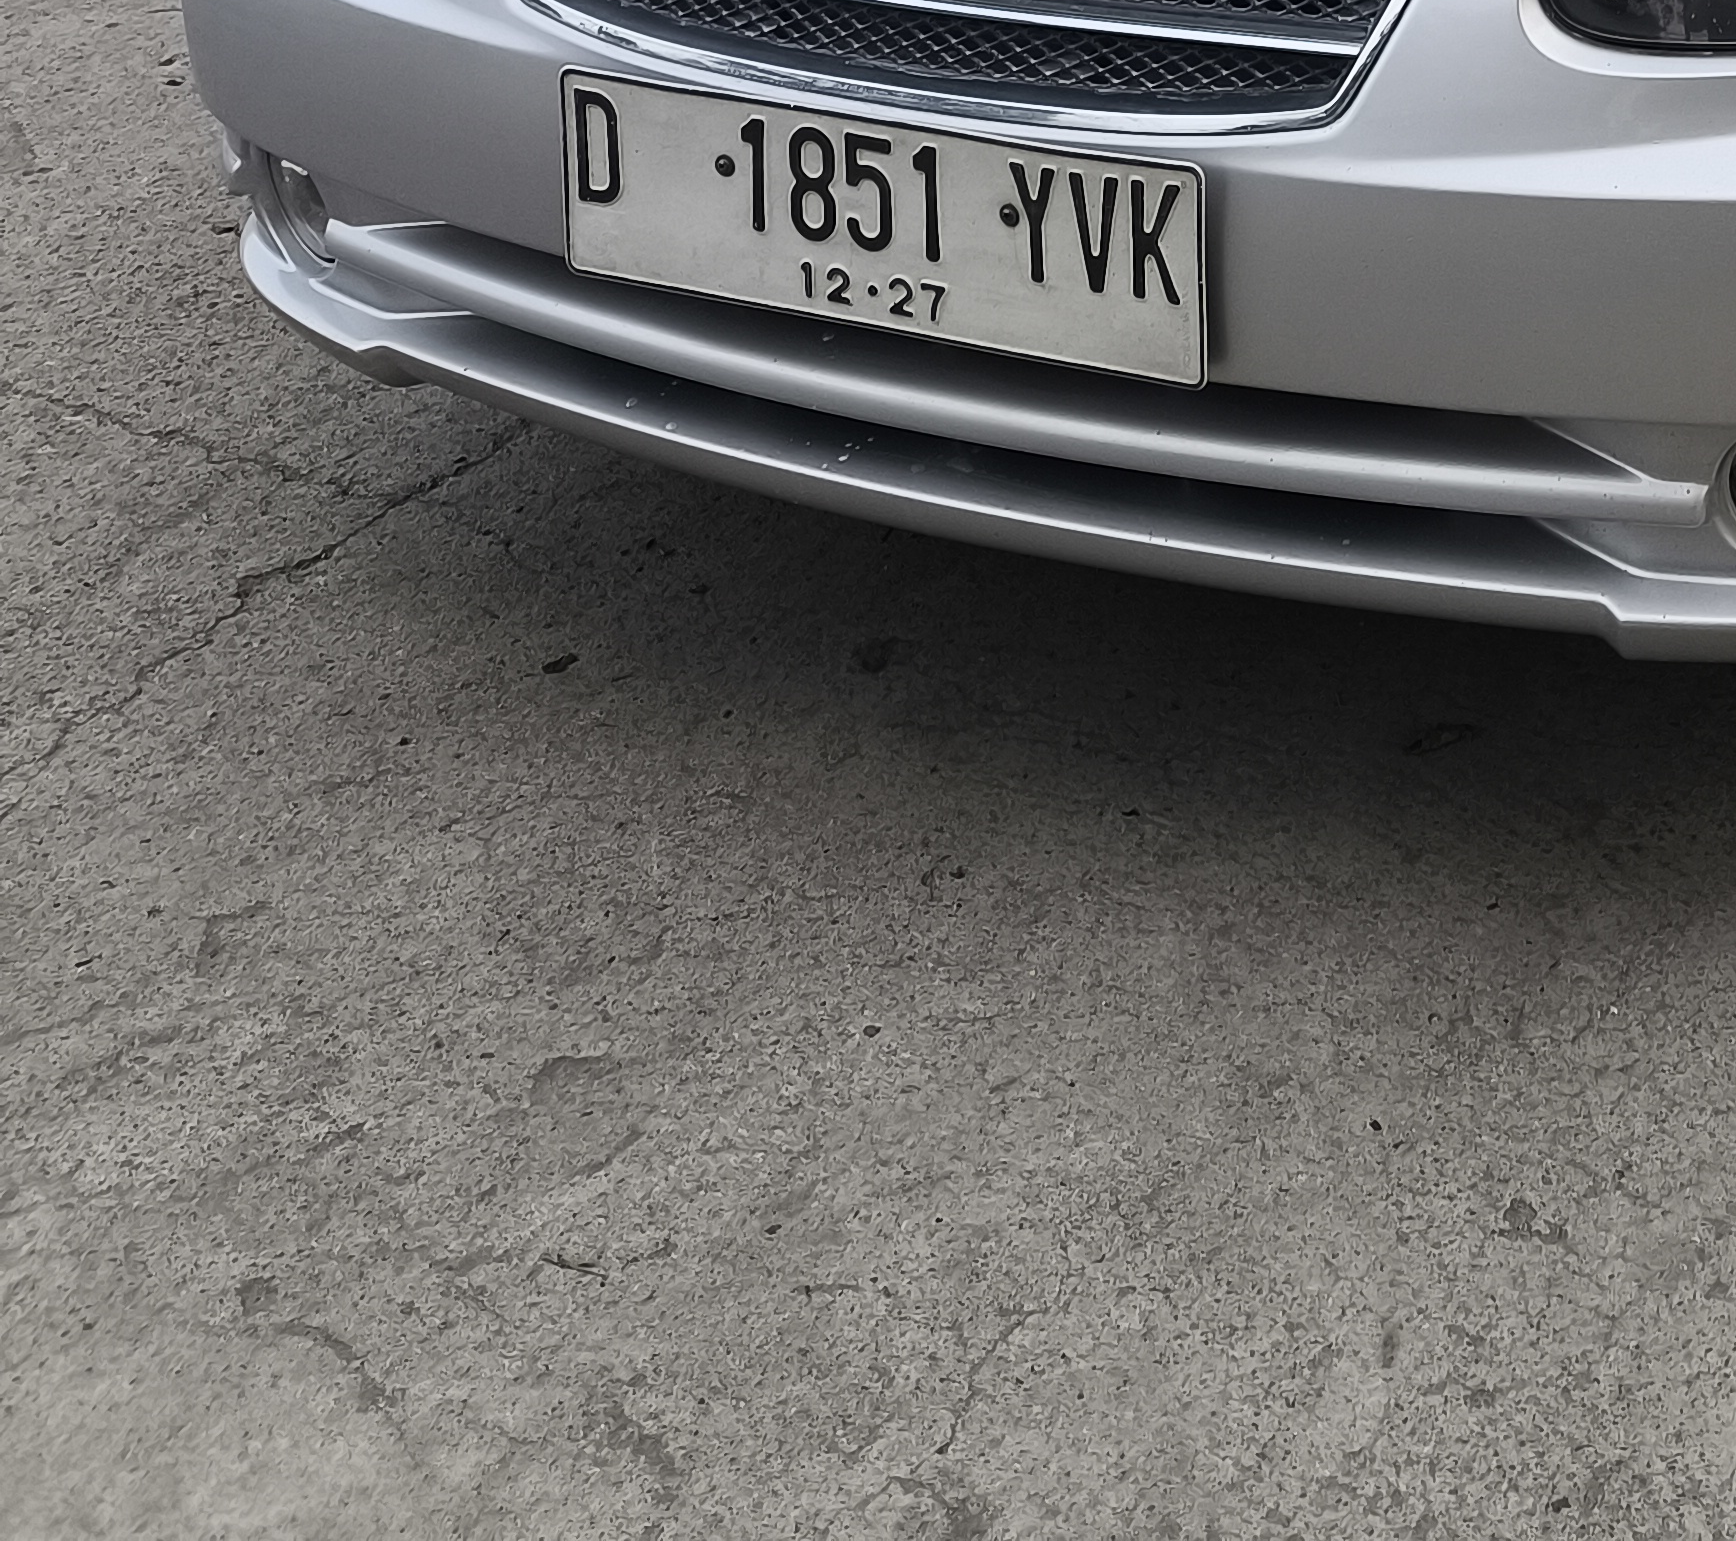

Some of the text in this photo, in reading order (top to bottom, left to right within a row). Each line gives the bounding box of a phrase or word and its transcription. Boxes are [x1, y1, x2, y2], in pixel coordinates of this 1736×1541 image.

[573, 85, 1182, 307] D 1851 YVK
